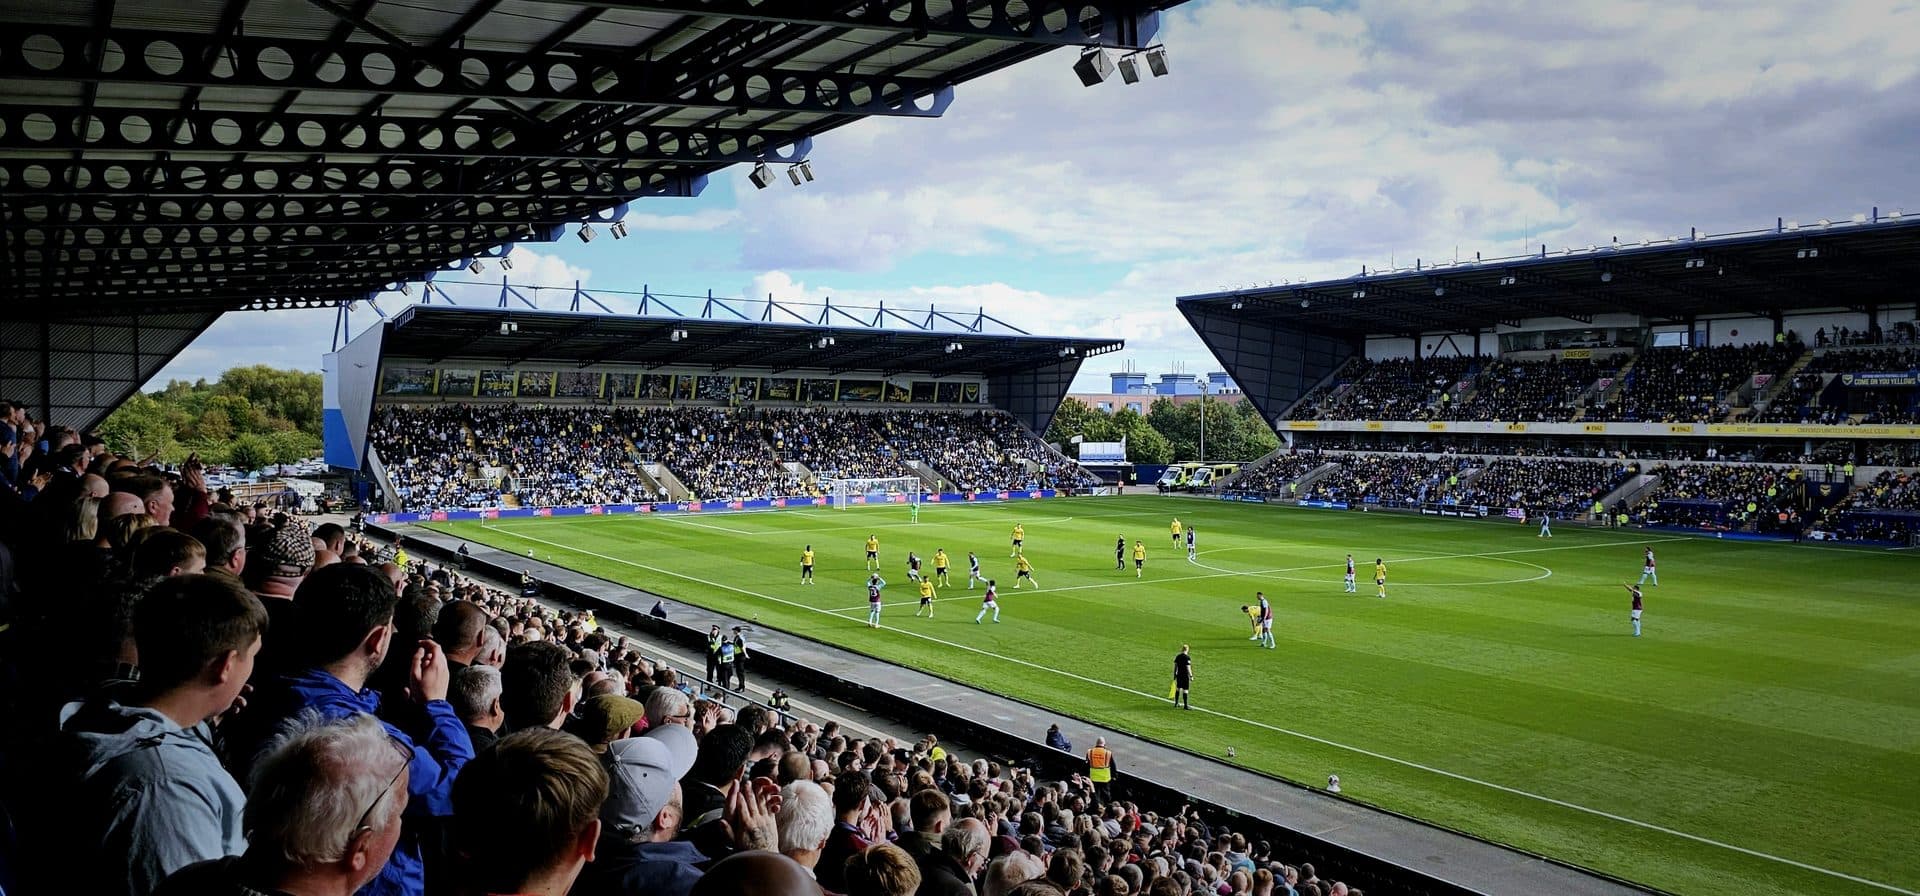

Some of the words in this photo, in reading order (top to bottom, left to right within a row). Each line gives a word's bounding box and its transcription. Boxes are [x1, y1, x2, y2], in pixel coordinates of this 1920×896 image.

[1565, 350, 1590, 358] OXFORD
[1890, 377, 1916, 385] YELLOWS
[418, 513, 431, 521] sky
